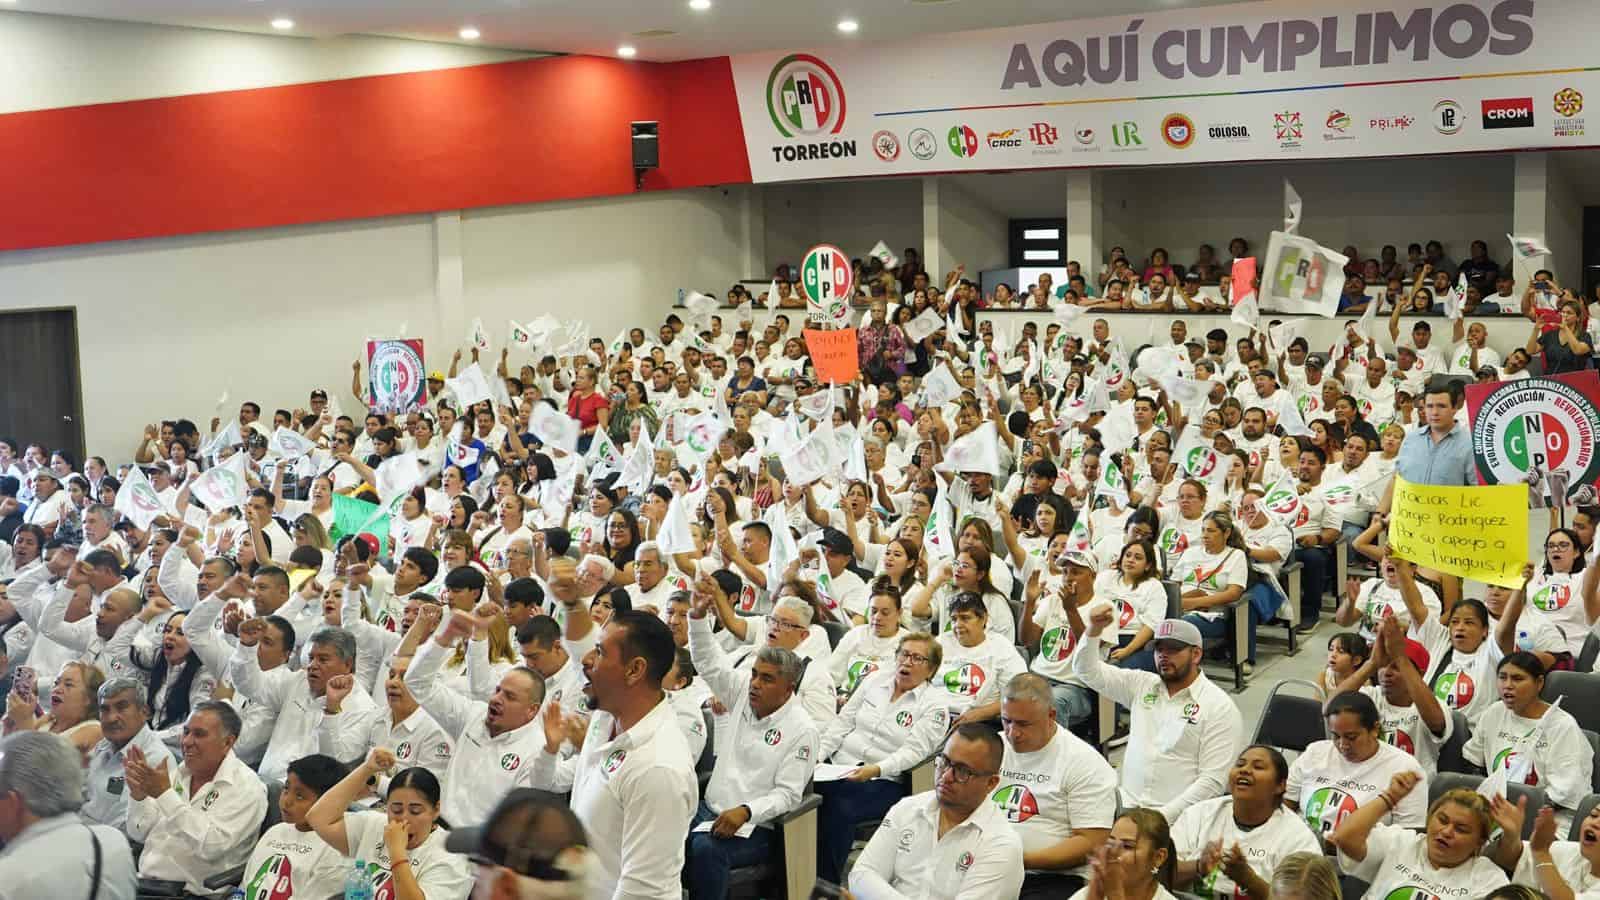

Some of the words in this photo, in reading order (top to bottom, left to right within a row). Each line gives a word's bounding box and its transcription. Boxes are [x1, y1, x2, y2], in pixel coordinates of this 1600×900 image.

[1001, 19, 1144, 89] AQUÍ
[1152, 0, 1534, 80] CUMPLIMOS
[1487, 107, 1528, 119] CROM
[772, 138, 857, 162] TORREÓN
[1495, 390, 1545, 417] REVOLUCIÓN
[1554, 397, 1592, 468] REVOLUCIONARIOS
[1401, 489, 1449, 505] racias
[1441, 536, 1487, 552] apoyo
[1494, 540, 1505, 549] a
